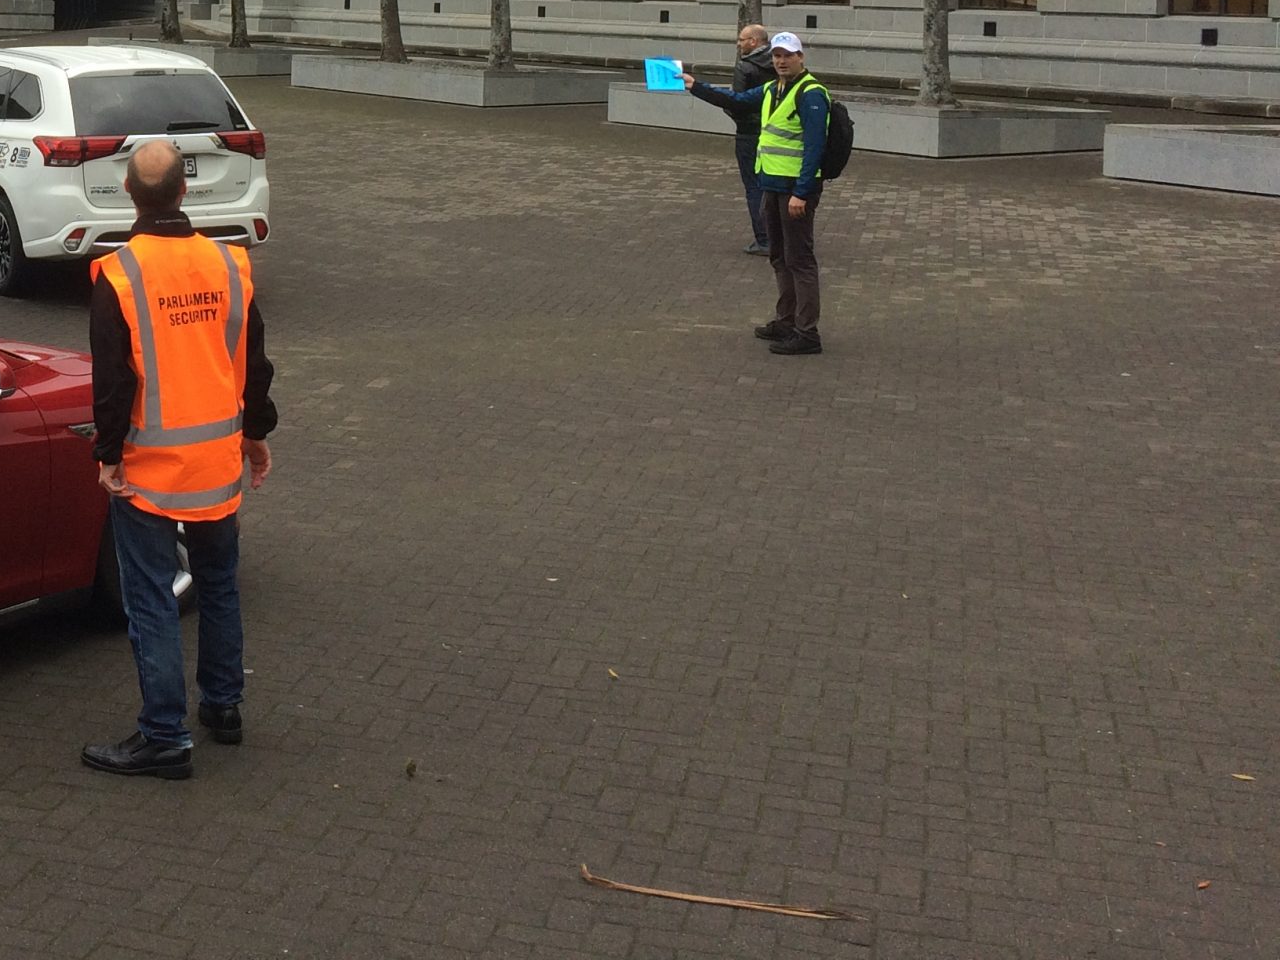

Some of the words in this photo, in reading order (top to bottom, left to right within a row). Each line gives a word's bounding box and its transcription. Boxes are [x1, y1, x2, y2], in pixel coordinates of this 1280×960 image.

[10, 147, 19, 163] 8
[158, 291, 224, 310] PARLIAMENT
[169, 308, 217, 326] SECURITY
